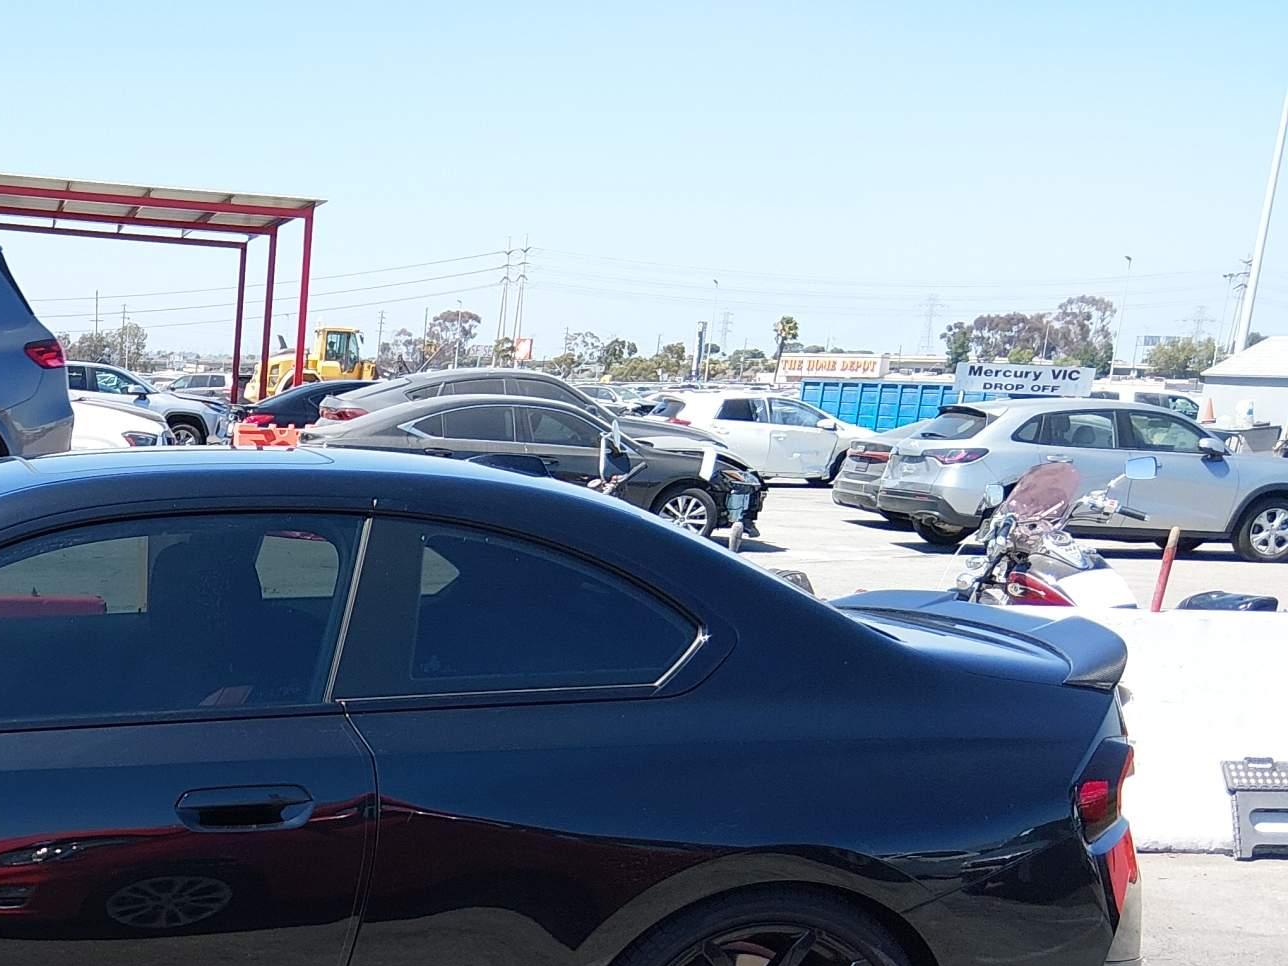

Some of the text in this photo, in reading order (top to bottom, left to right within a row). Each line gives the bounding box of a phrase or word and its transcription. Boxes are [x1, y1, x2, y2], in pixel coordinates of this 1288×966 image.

[781, 359, 803, 371] THE
[840, 360, 877, 373] DEPOT
[968, 365, 1081, 381] Mercury VIC
[983, 382, 1061, 393] DROP OFF
